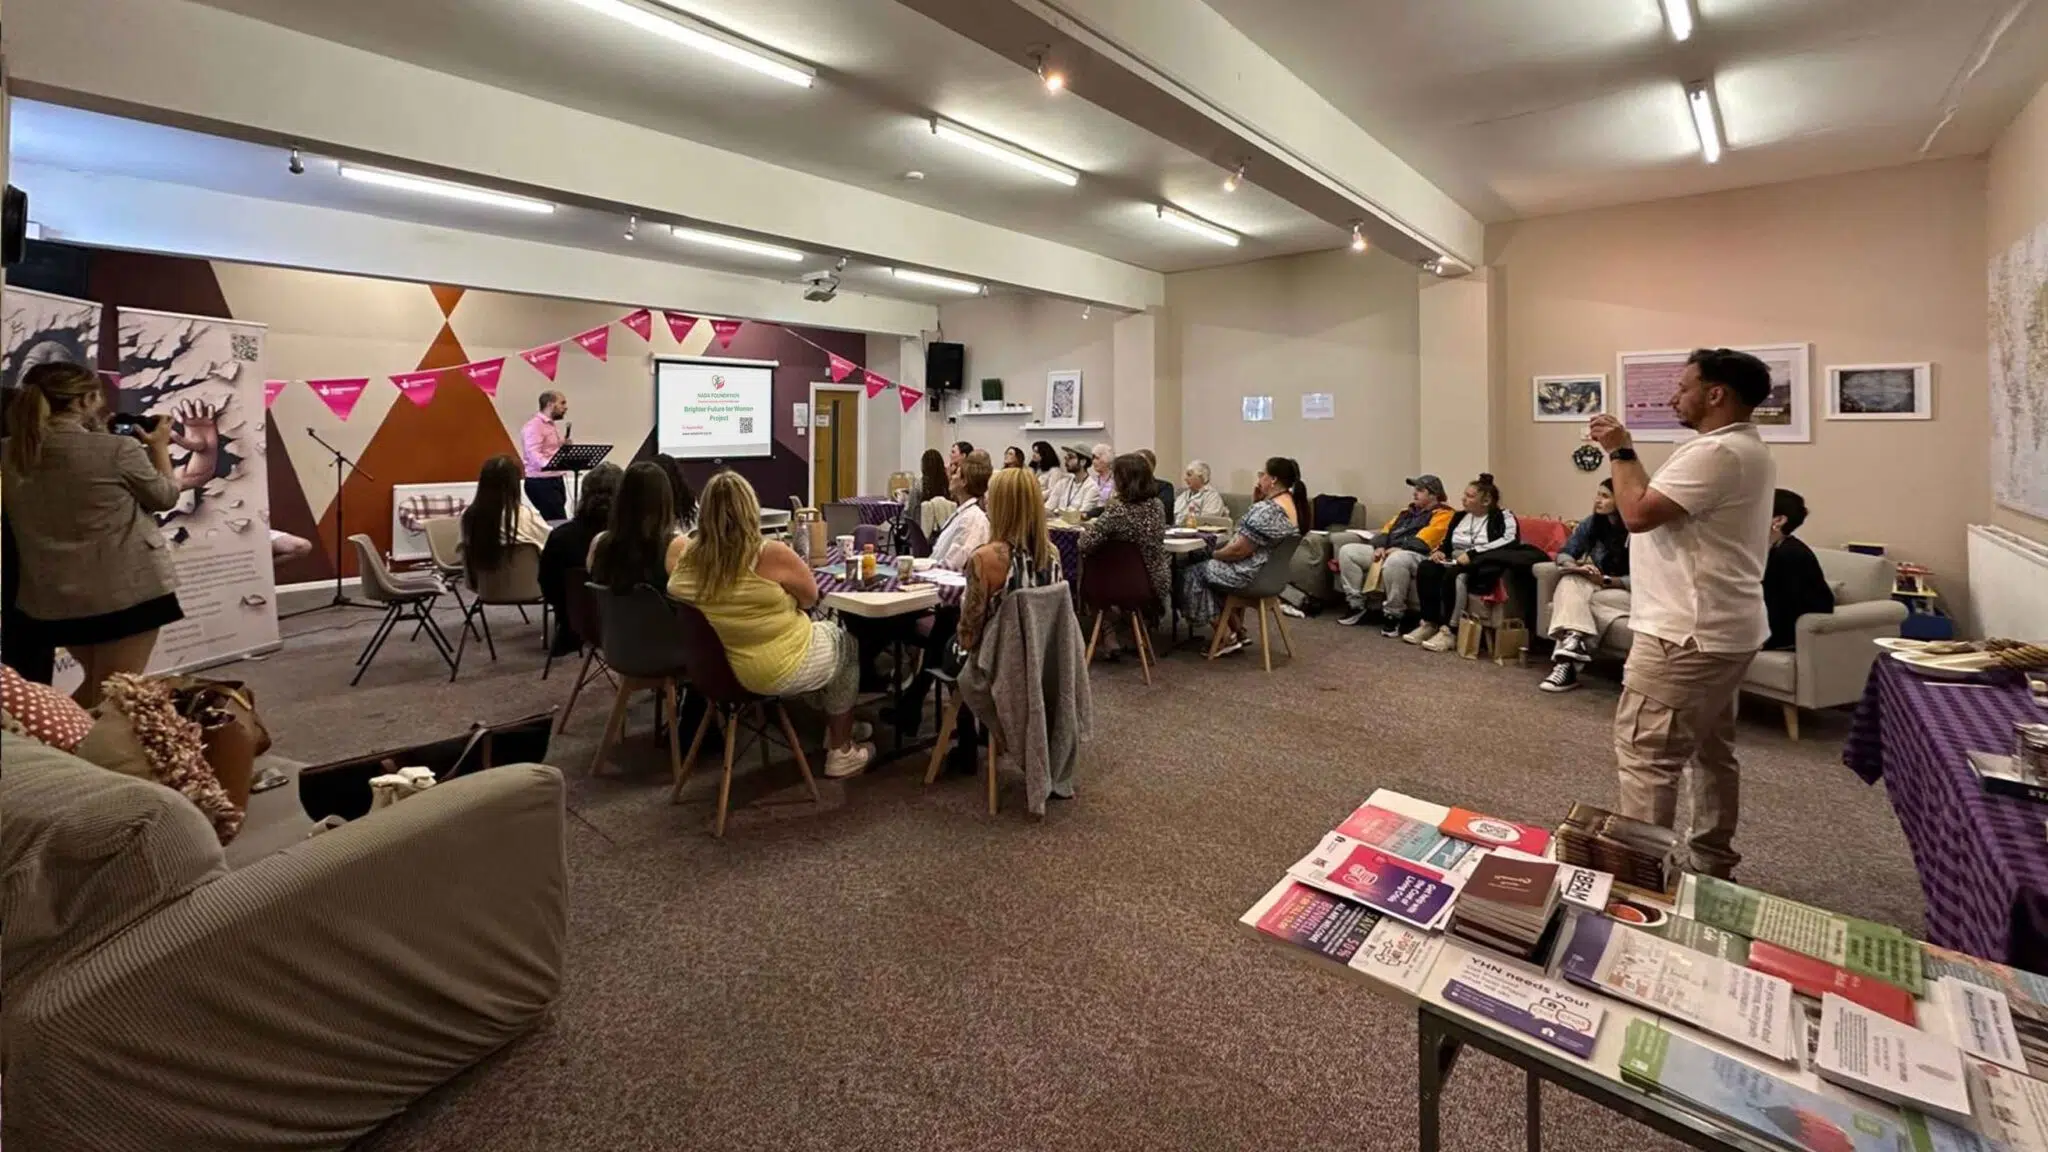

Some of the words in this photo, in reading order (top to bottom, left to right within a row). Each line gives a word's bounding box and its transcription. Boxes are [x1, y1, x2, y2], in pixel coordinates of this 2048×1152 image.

[1397, 875, 1416, 891] Living
[1414, 879, 1426, 889] the
[1423, 884, 1437, 894] Get
[1387, 890, 1403, 902] Crisis
[1405, 888, 1419, 900] Cost
[1415, 893, 1429, 905] help
[1406, 903, 1418, 913] with
[1296, 900, 1333, 935] BENWELL
[1354, 912, 1379, 935] SAVE
[1336, 938, 1359, 958] 50%
[1471, 957, 1503, 974] YHN
[1505, 970, 1552, 993] needs
[1554, 991, 1591, 1009] you!
